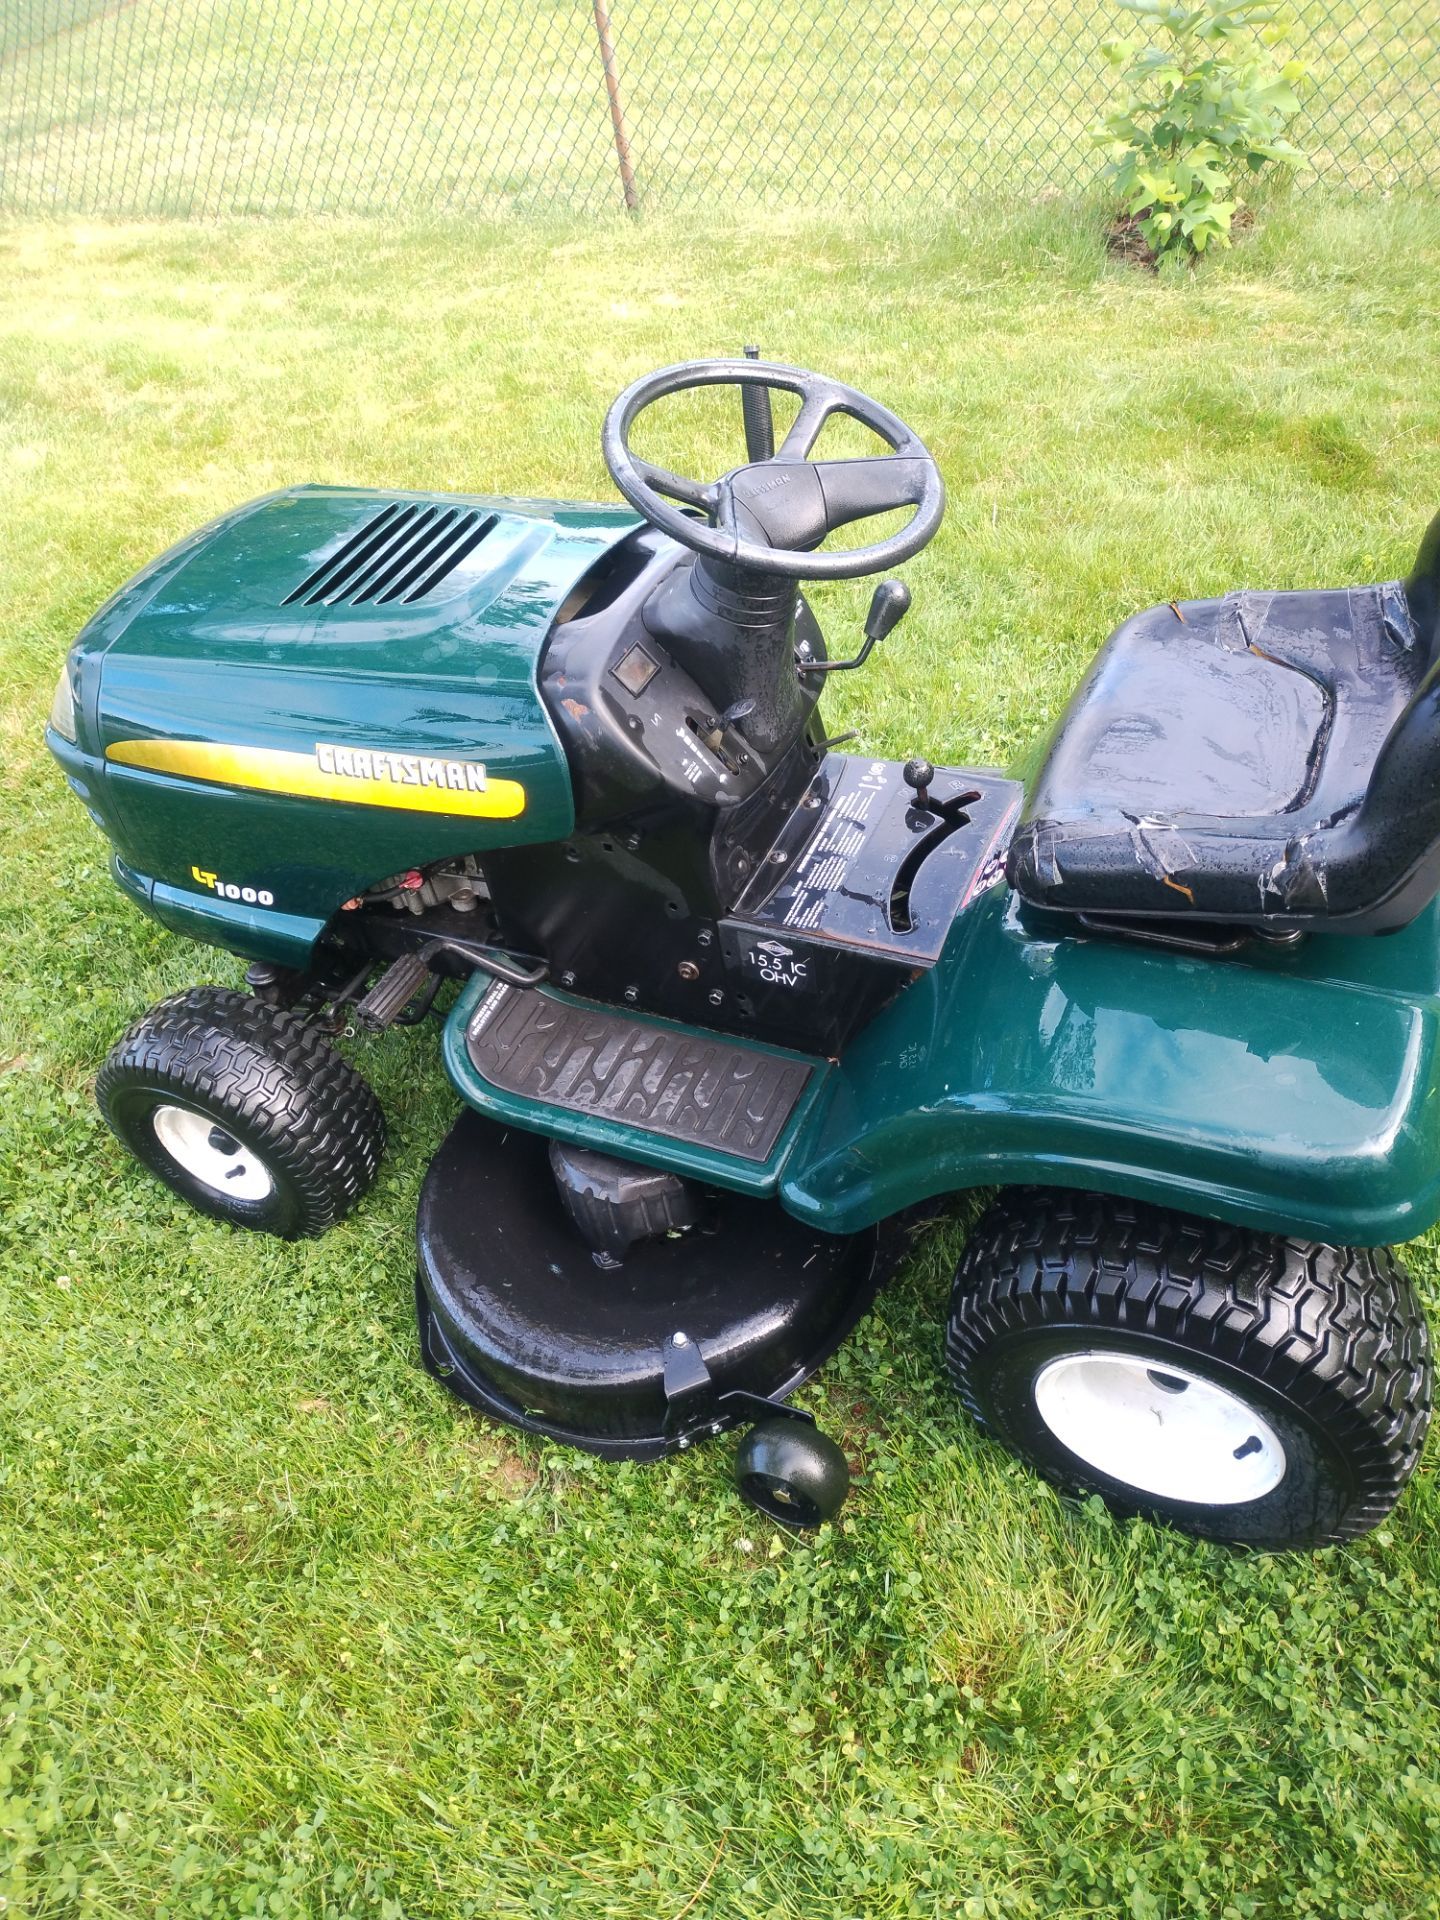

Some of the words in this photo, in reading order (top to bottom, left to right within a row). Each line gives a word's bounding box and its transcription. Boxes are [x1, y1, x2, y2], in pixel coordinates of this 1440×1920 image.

[317, 747, 487, 792] CRAFTSMAN
[748, 951, 782, 970] 15.5
[790, 961, 806, 976] IC
[760, 969, 798, 987] OHV
